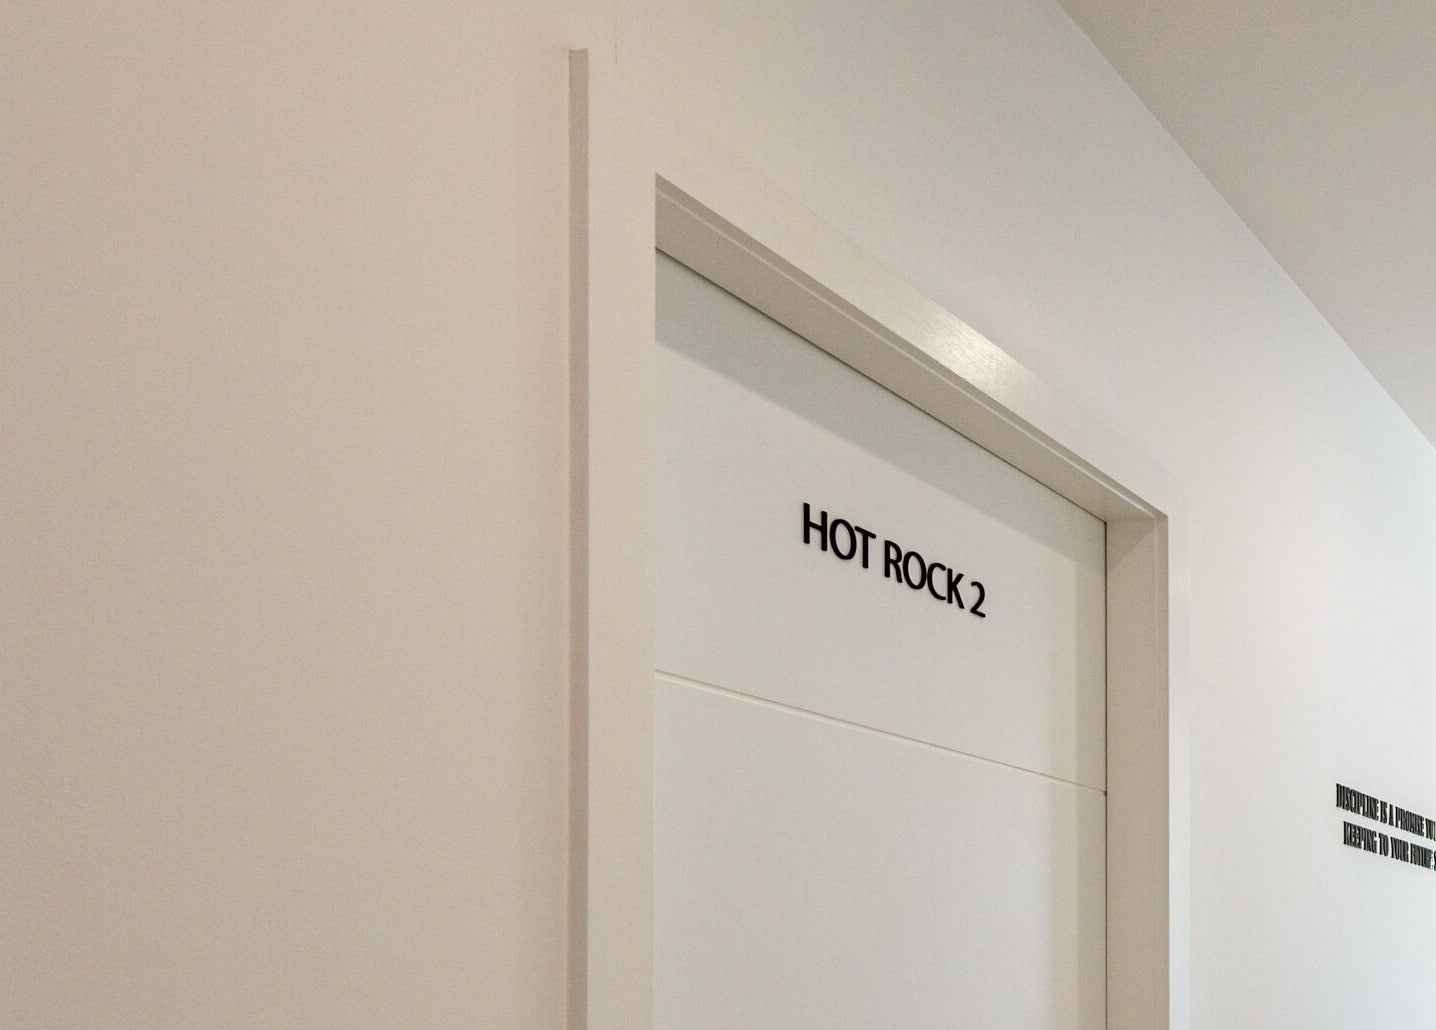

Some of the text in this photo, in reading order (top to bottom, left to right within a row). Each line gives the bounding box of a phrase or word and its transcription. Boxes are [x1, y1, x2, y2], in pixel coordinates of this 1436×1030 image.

[803, 502, 986, 618] HOT ROCK 2
[1336, 783, 1379, 821] DISCIPLINE
[1380, 800, 1388, 824] IS
[1388, 804, 1395, 827] A
[1395, 806, 1424, 837] PROMISE
[1343, 821, 1377, 854] KEEPING
[1378, 832, 1389, 857] TO
[1390, 836, 1409, 863] YOUR
